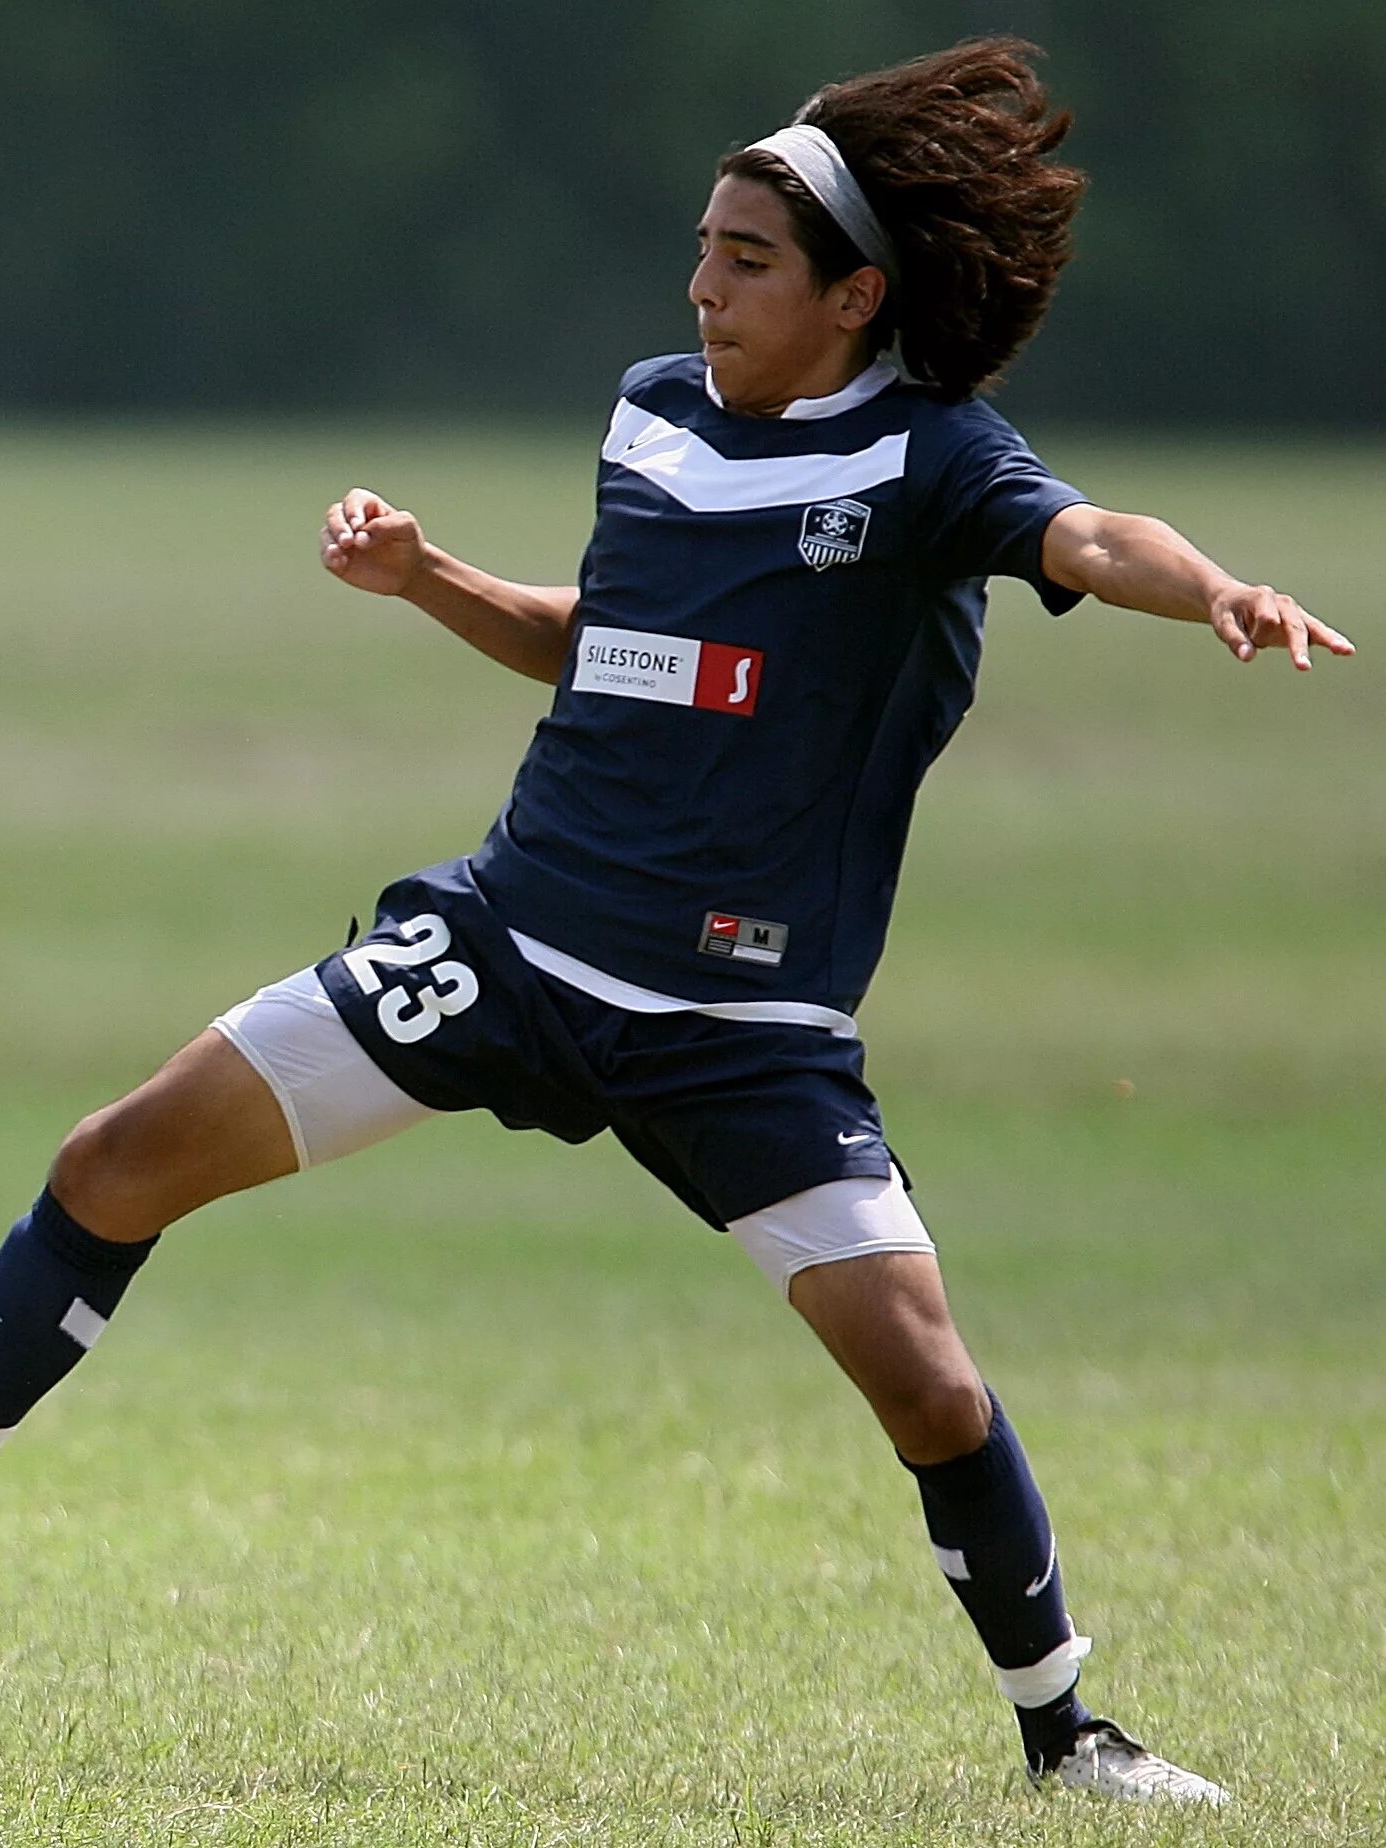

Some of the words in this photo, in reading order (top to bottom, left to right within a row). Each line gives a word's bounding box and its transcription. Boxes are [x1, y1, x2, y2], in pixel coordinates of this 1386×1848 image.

[587, 645, 678, 674] SILESTONE
[752, 926, 770, 945] M
[342, 913, 480, 1043] 23
